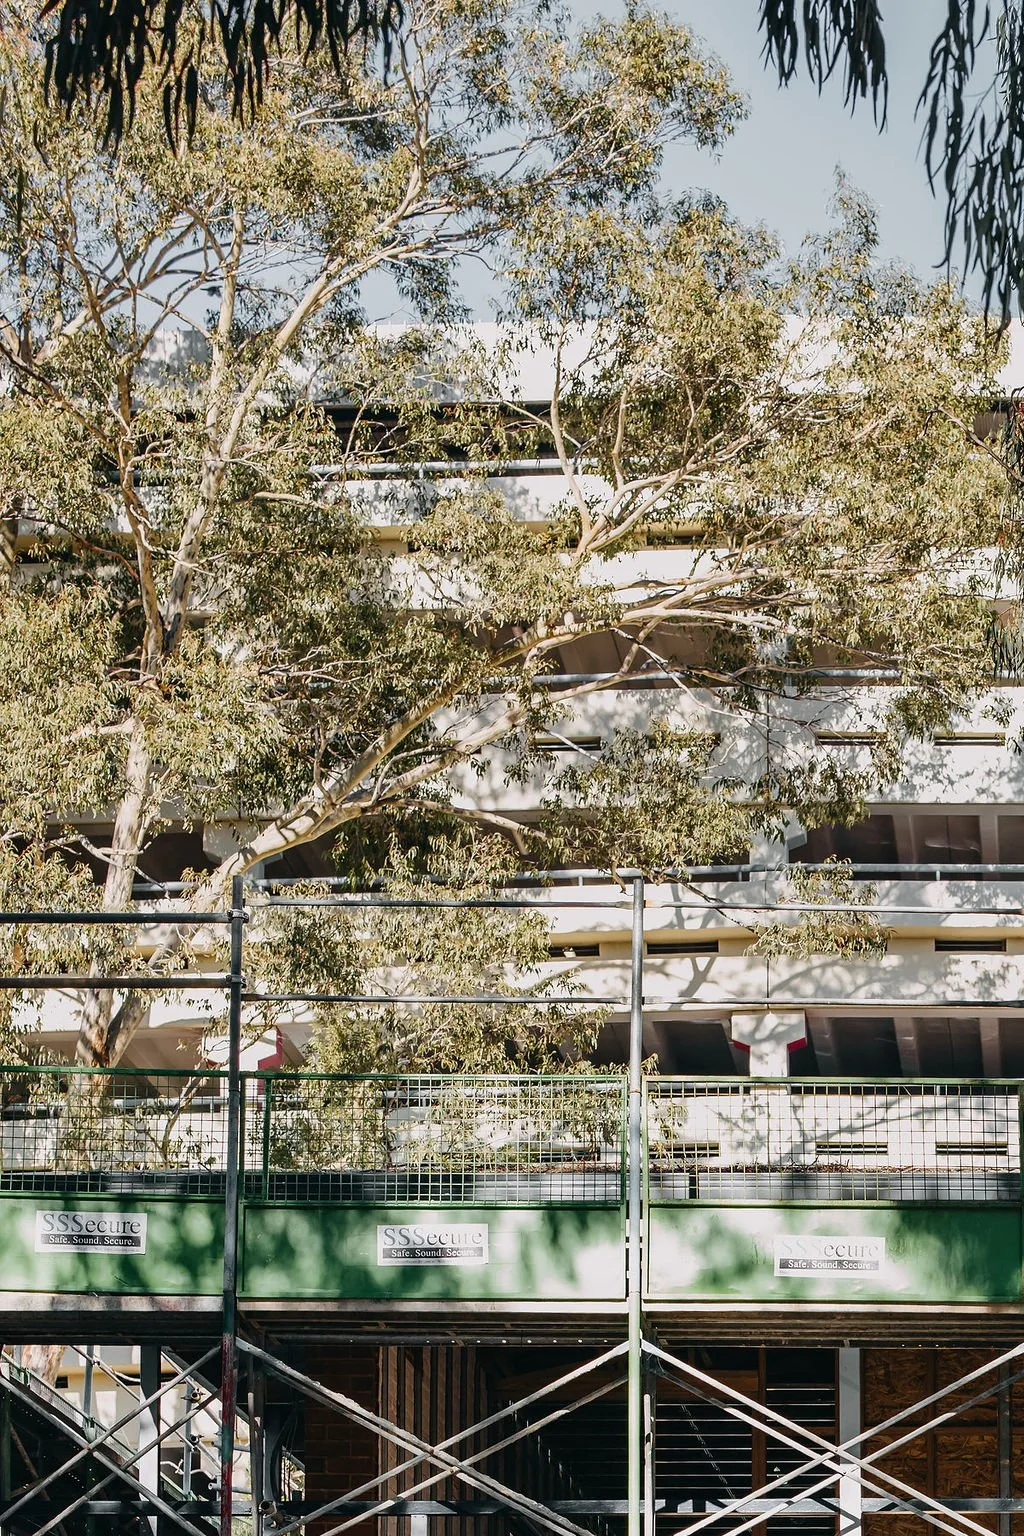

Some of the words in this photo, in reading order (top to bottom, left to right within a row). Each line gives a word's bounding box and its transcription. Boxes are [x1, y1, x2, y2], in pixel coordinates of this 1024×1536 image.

[42, 1213, 141, 1234] SSSecure
[49, 1234, 71, 1244] Safe.
[72, 1235, 102, 1245] Sound.
[103, 1236, 135, 1246] Secure.
[383, 1227, 482, 1246] SSSecure
[391, 1248, 413, 1258] Safe.
[415, 1248, 444, 1257] Sound.
[782, 1239, 879, 1258] SSecure
[788, 1259, 809, 1269] Safe.
[811, 1260, 841, 1269] Sound.
